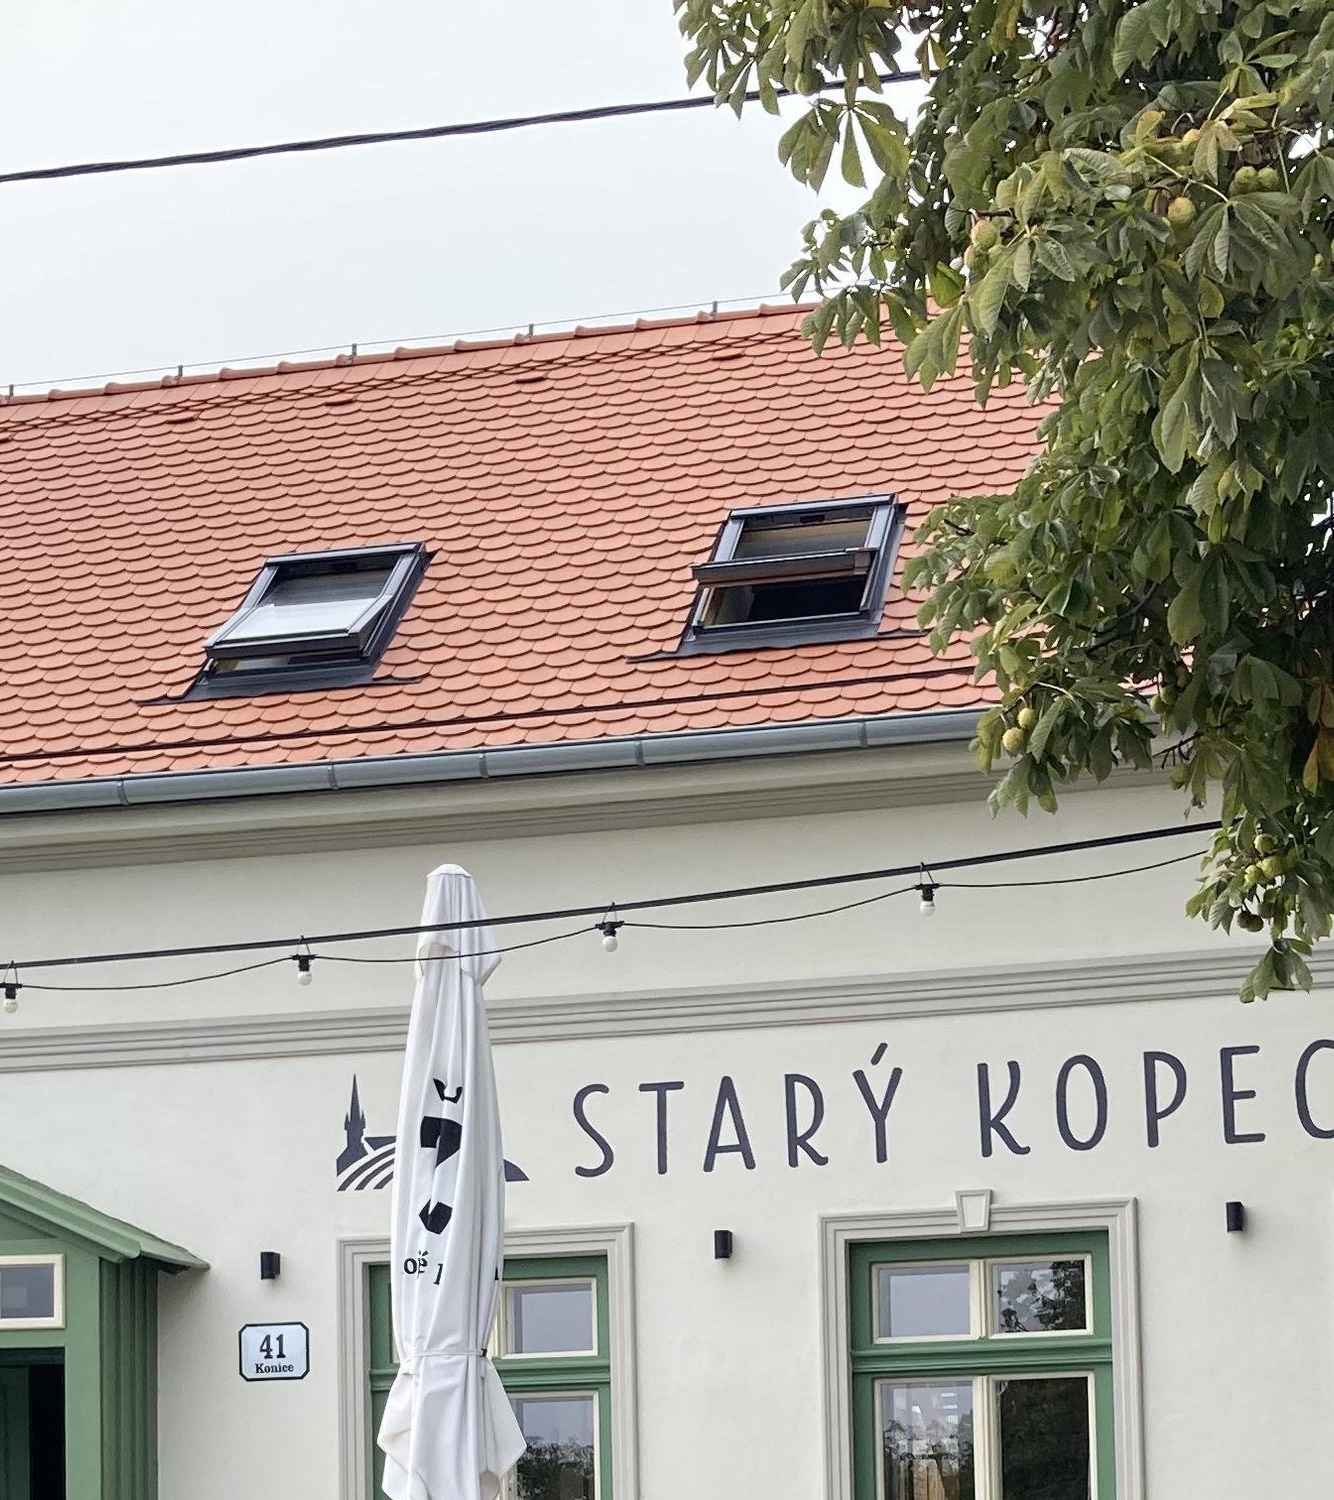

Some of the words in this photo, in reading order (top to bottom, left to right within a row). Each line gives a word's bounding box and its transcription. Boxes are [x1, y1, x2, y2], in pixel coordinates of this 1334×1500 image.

[573, 1042, 904, 1179] STARÝ
[259, 1333, 286, 1360] 41
[254, 1362, 295, 1374] Konice
